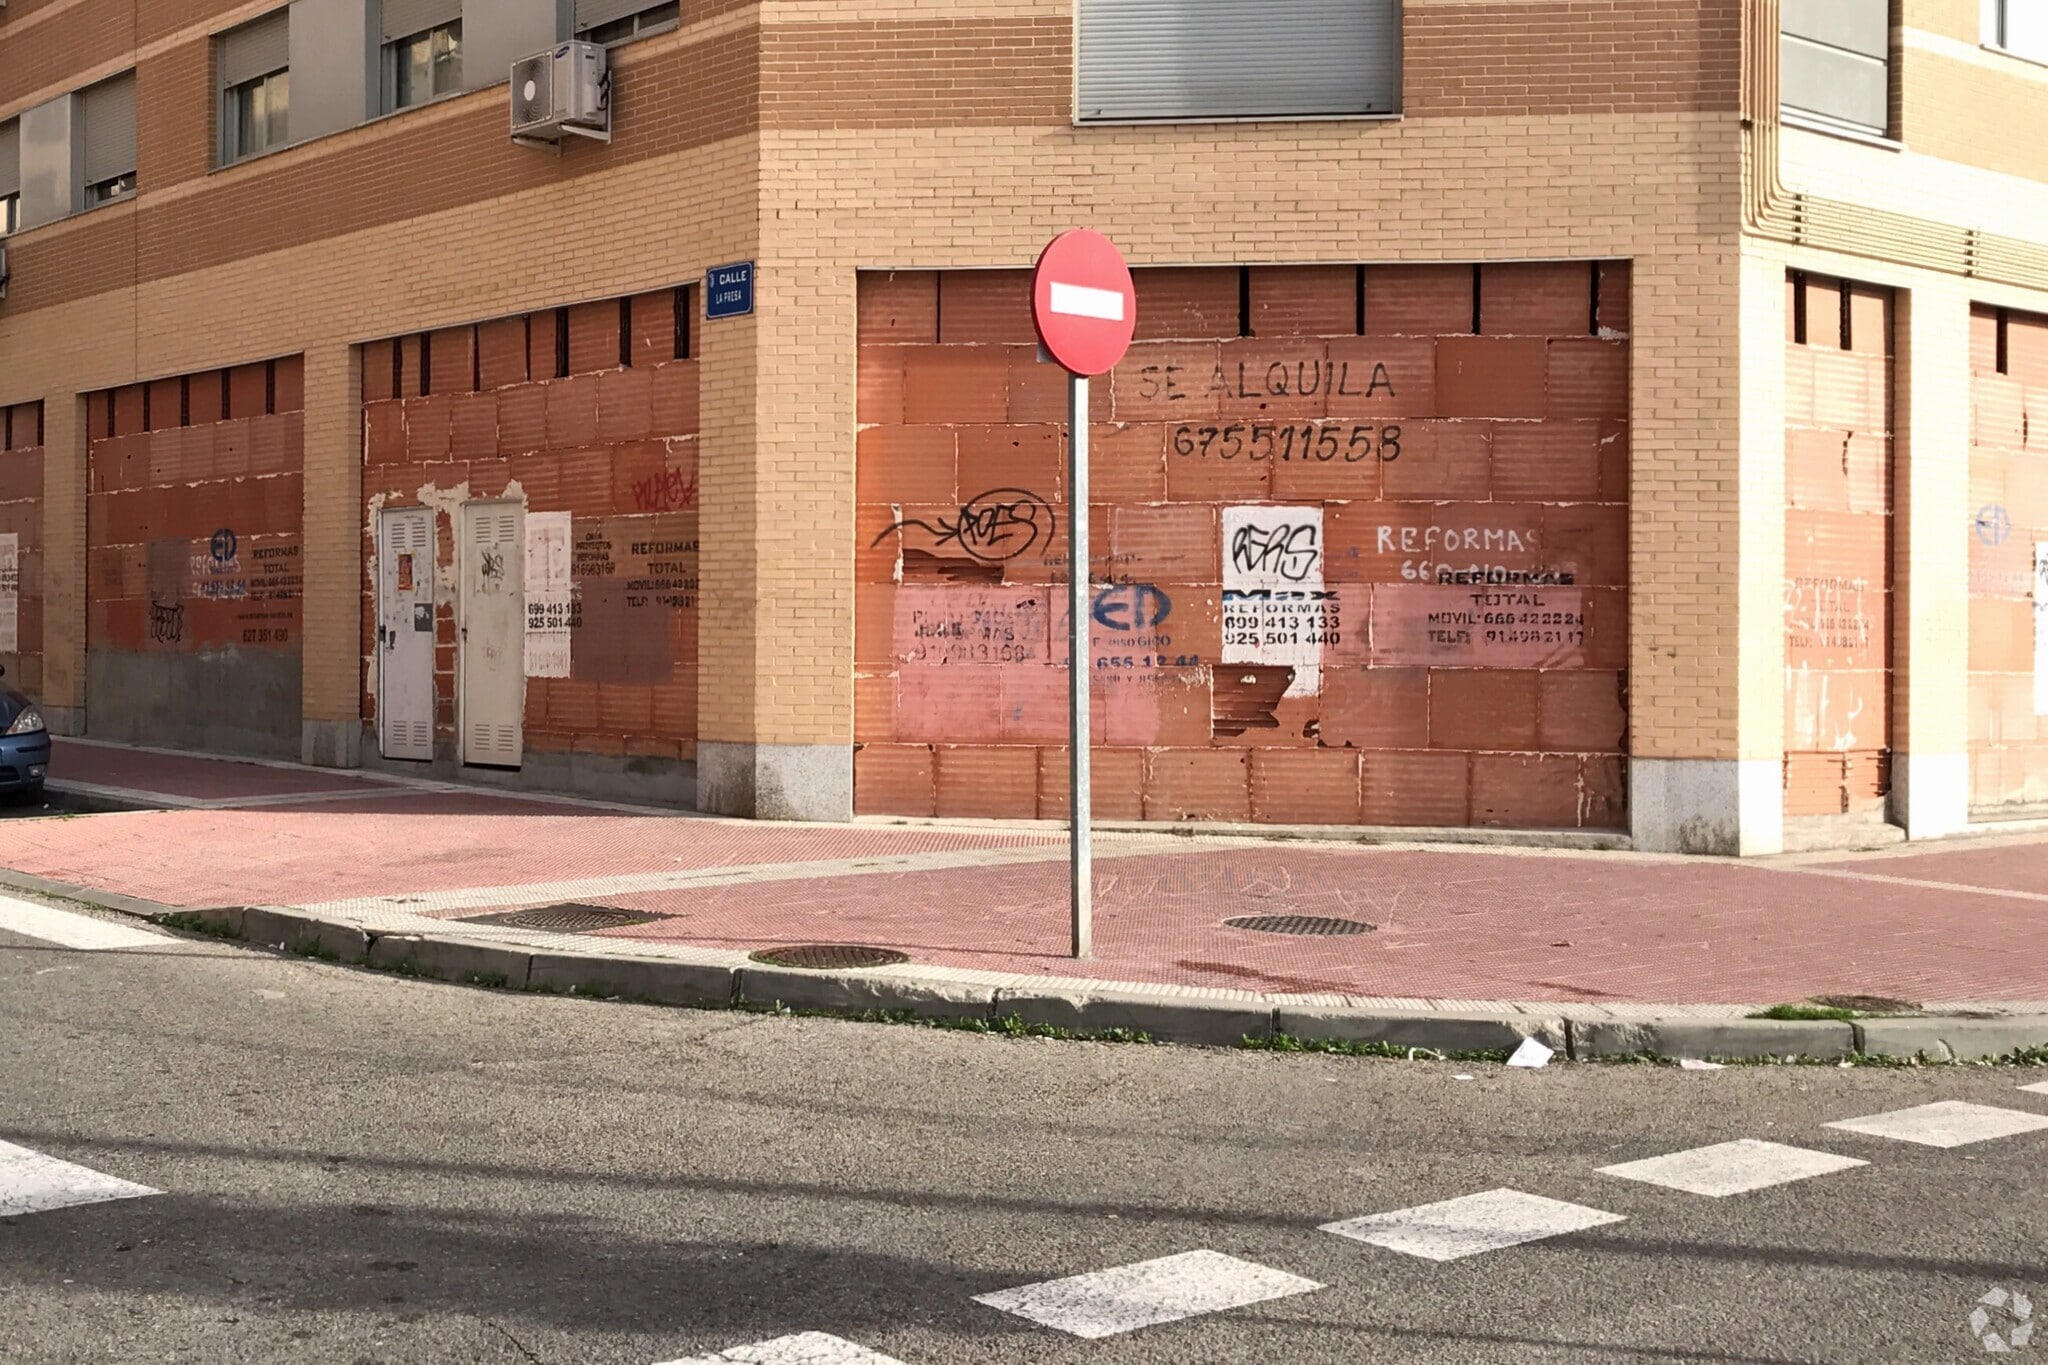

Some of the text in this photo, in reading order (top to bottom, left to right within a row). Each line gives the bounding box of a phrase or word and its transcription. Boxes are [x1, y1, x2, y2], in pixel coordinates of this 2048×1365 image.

[719, 270, 747, 285] CALLE
[1140, 360, 1396, 399] SE ALQUILA
[1174, 423, 1401, 462] 675511558
[1377, 525, 1538, 554] REFORMAS
[264, 563, 289, 573] TOTAL
[647, 562, 687, 575] TOTAL
[1469, 593, 1546, 607] TOTAL
[528, 603, 583, 615] 699 413 133
[1224, 603, 1342, 614] REFORMAS
[528, 617, 583, 629] 925 501 440
[1224, 615, 1341, 630] 699 413 133
[1224, 632, 1341, 649] 925 501 440
